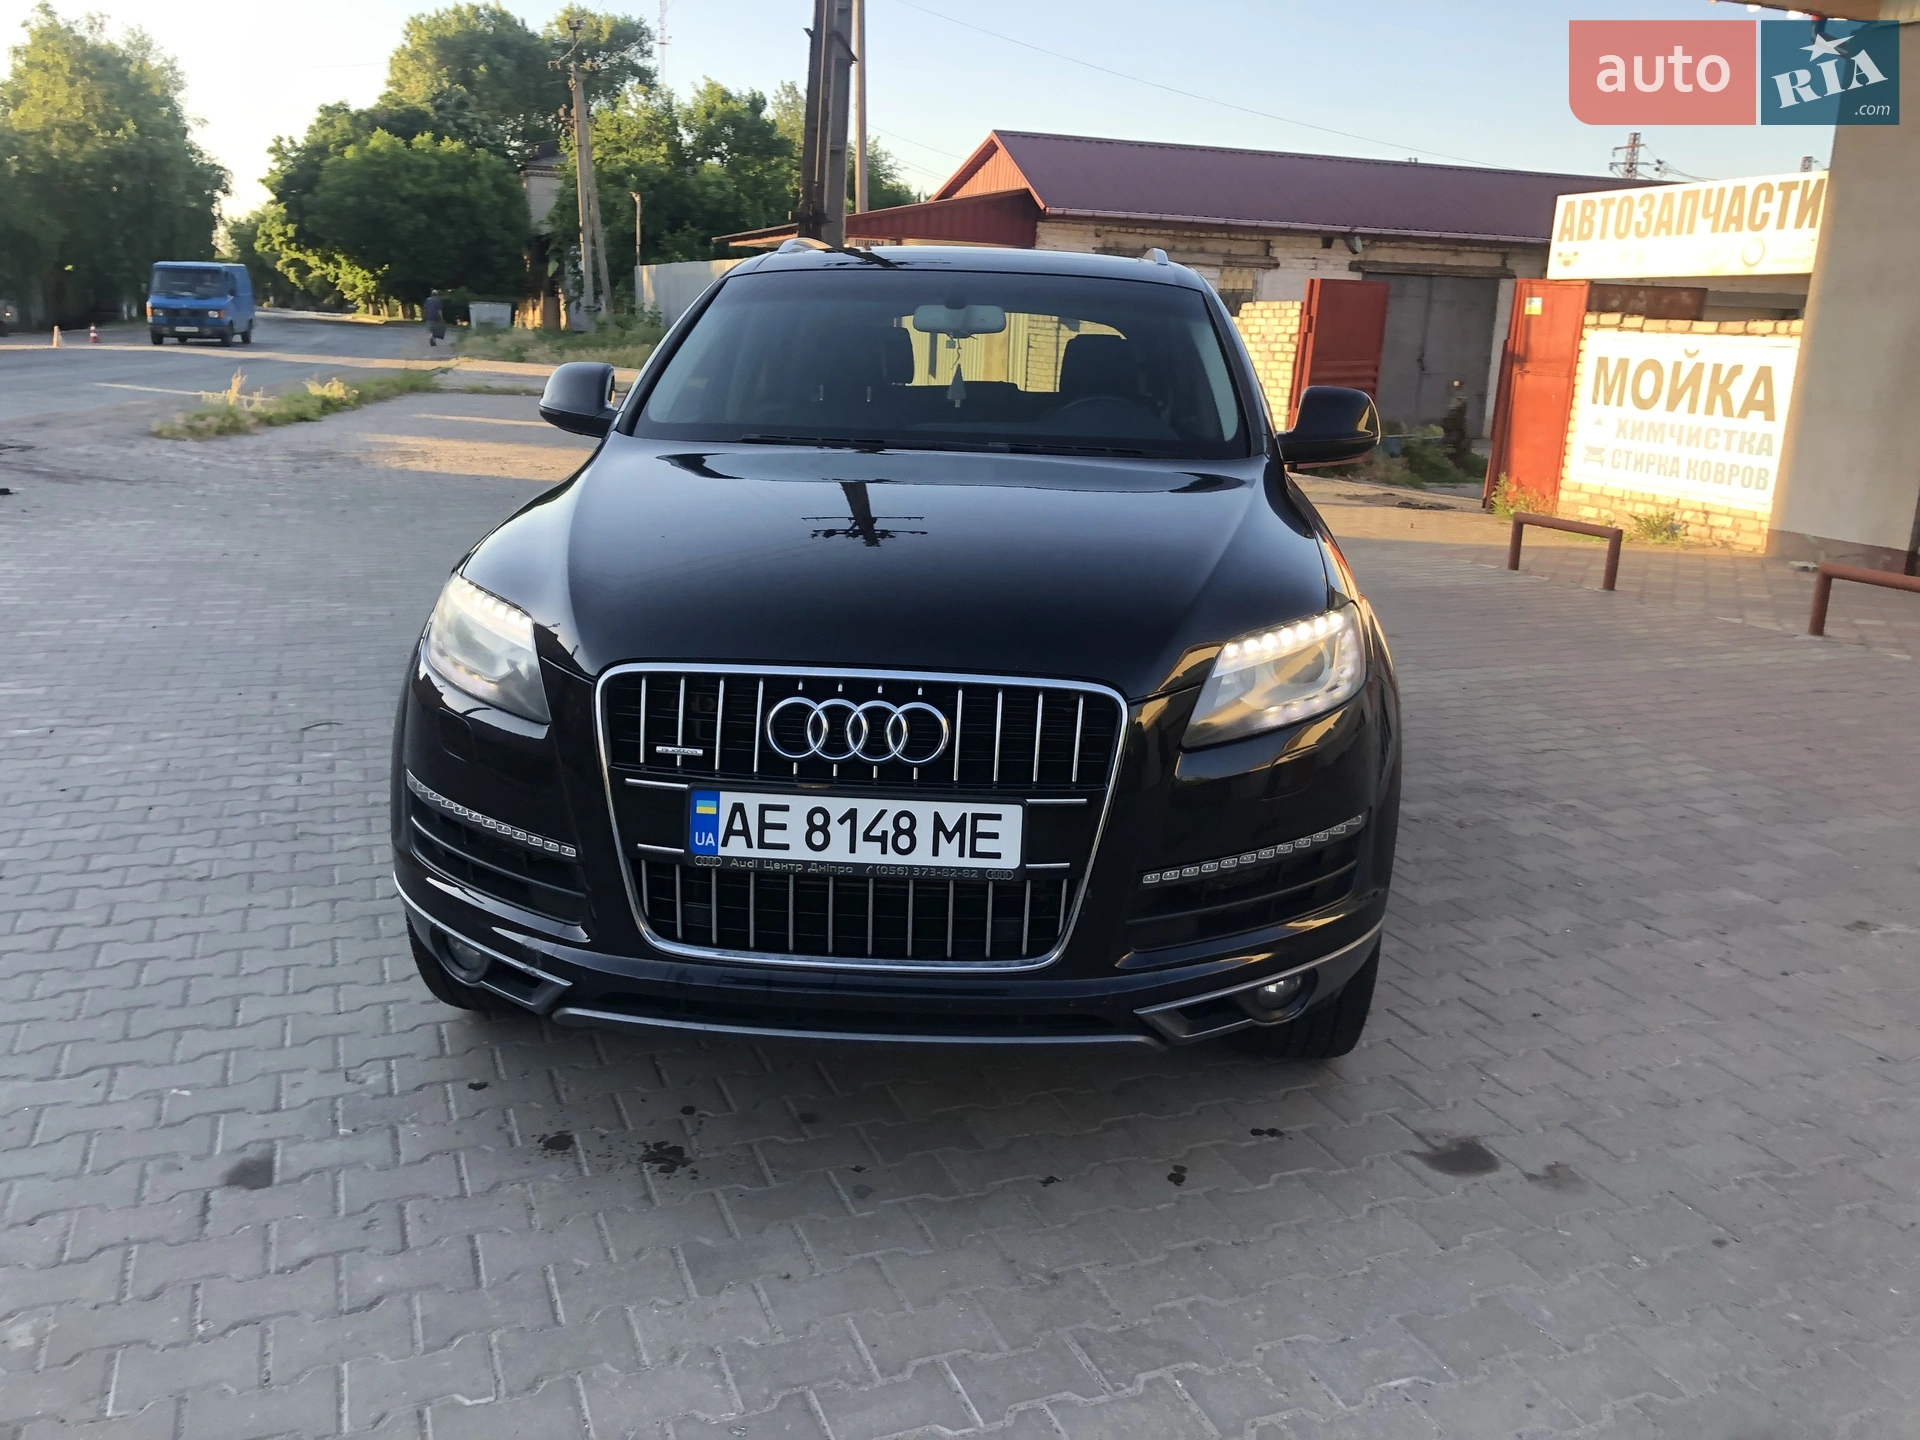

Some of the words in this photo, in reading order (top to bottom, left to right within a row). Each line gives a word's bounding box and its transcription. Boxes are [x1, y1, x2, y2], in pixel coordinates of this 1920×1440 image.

[1557, 178, 1826, 243] АВТОЗАПЧАСТИ
[1591, 348, 1776, 422] МОЙКА
[1615, 417, 1774, 457] ХИМЧИСТКА
[1610, 448, 1681, 479] СТИРКА
[1685, 458, 1770, 491] КОВРОВ
[694, 831, 716, 847] UA
[720, 802, 790, 851] AE
[804, 806, 917, 856] 8148
[931, 810, 1003, 860] ME
[730, 858, 758, 868] Audi
[763, 860, 803, 871] Центр
[807, 862, 853, 874] Дніпро
